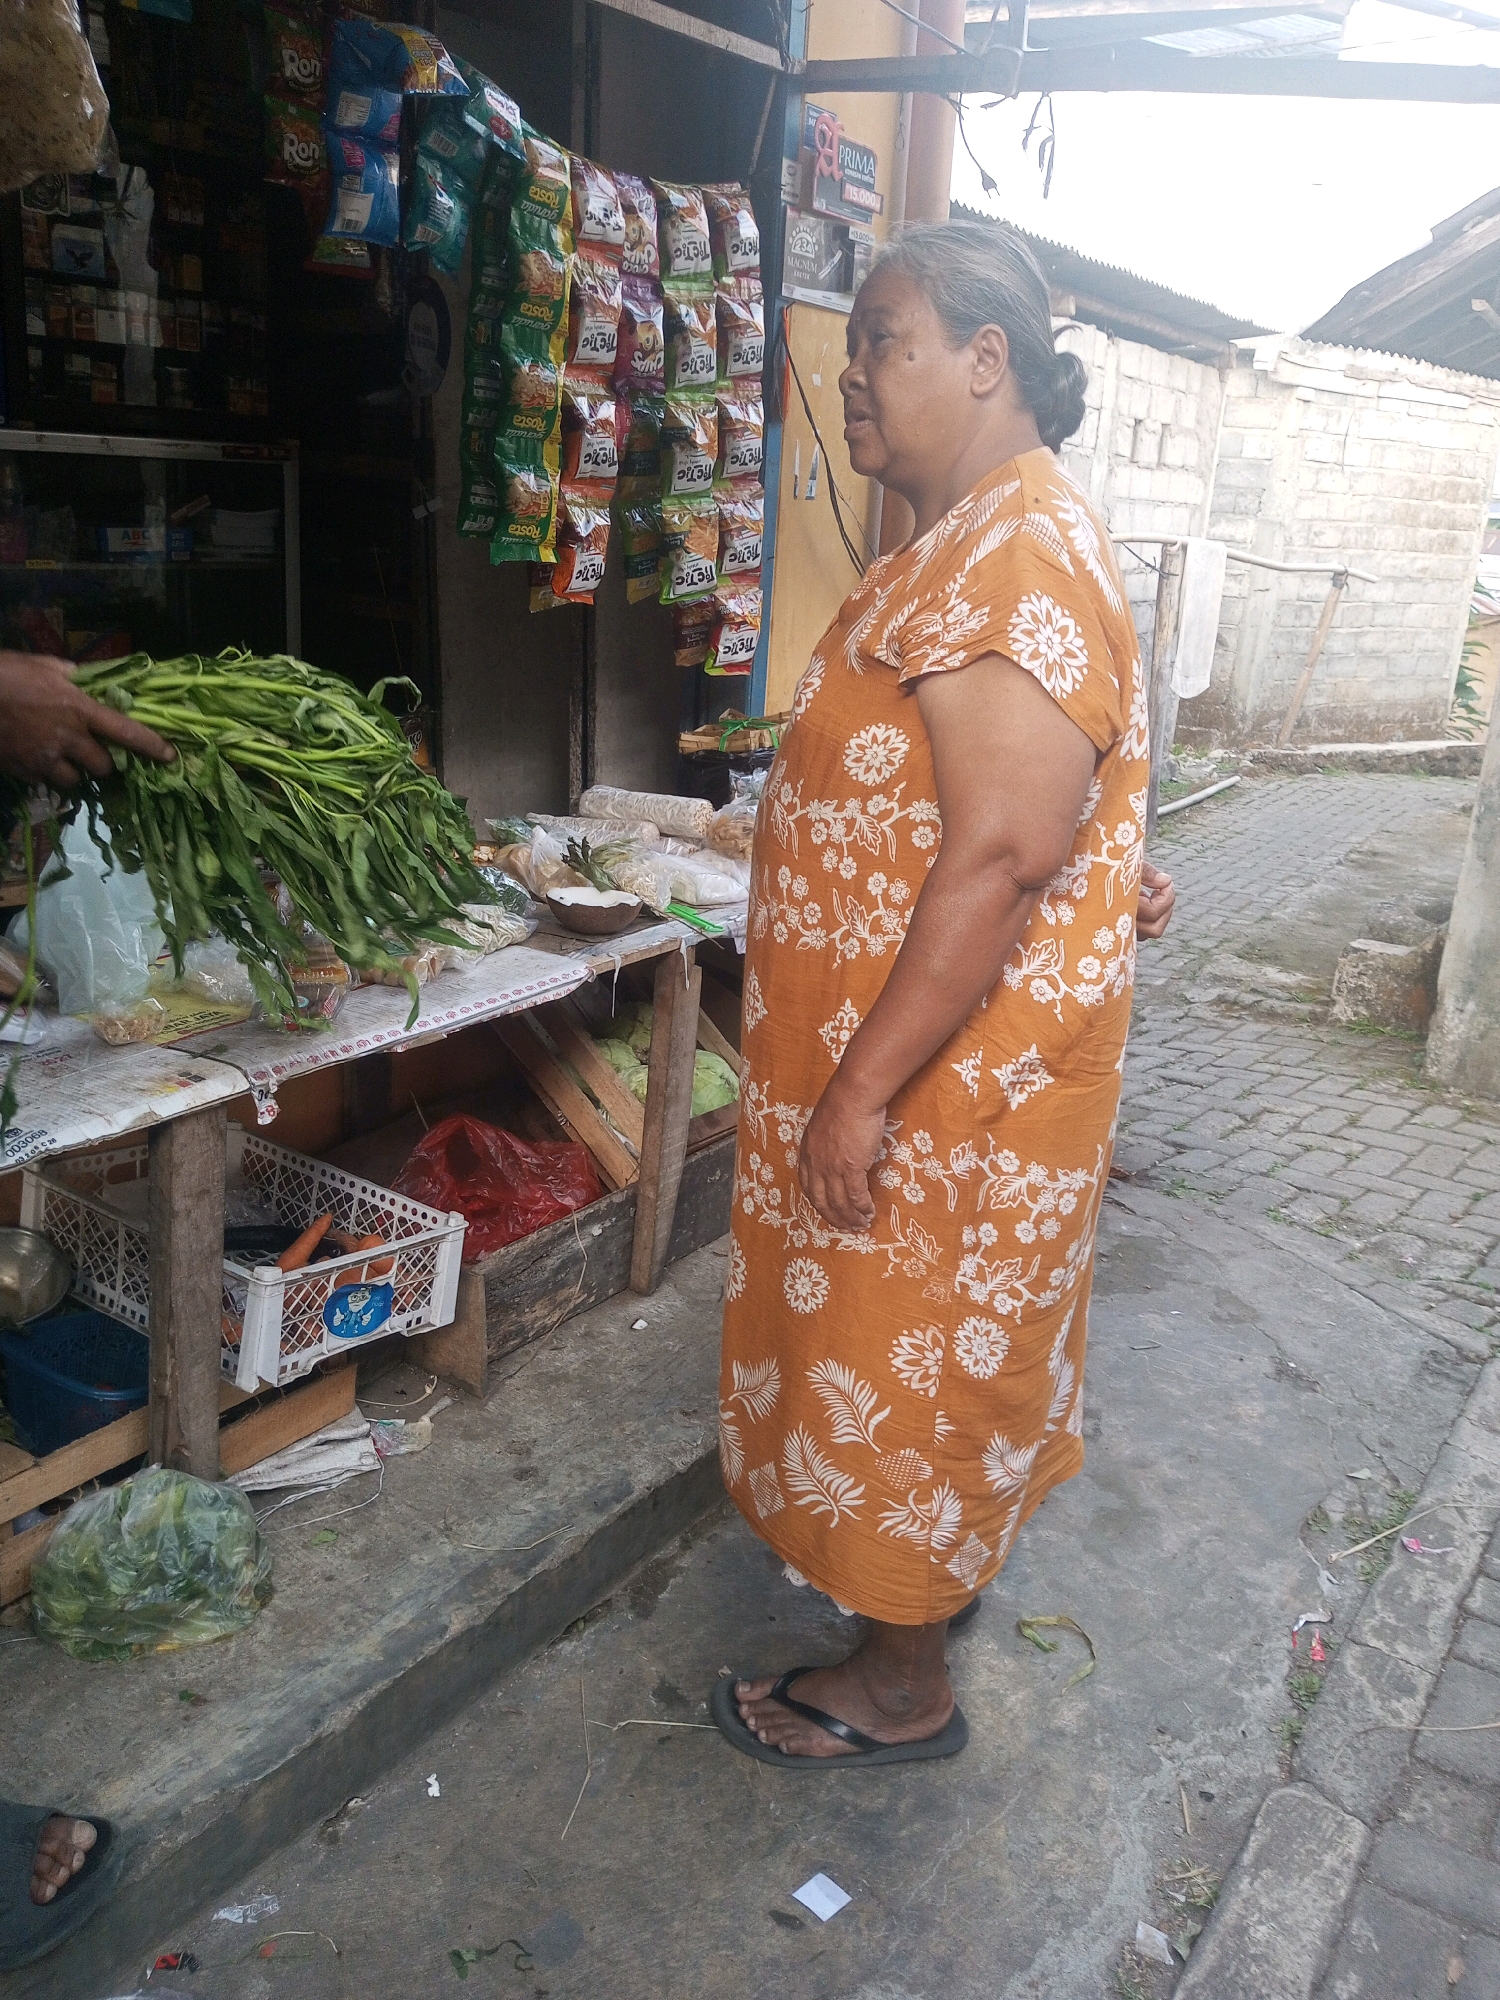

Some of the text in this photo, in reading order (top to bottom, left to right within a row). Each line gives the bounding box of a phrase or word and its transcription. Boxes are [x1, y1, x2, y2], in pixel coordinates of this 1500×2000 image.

[839, 145, 875, 176] PRIMA
[528, 185, 560, 206] Rosta
[795, 237, 813, 254] 234
[786, 255, 818, 274] MAGNUM
[519, 301, 553, 320] Rosta
[511, 316, 552, 331] garuda
[512, 415, 547, 431] Rosta
[508, 523, 542, 539] Rosta
[5, 1129, 48, 1158] 003068
